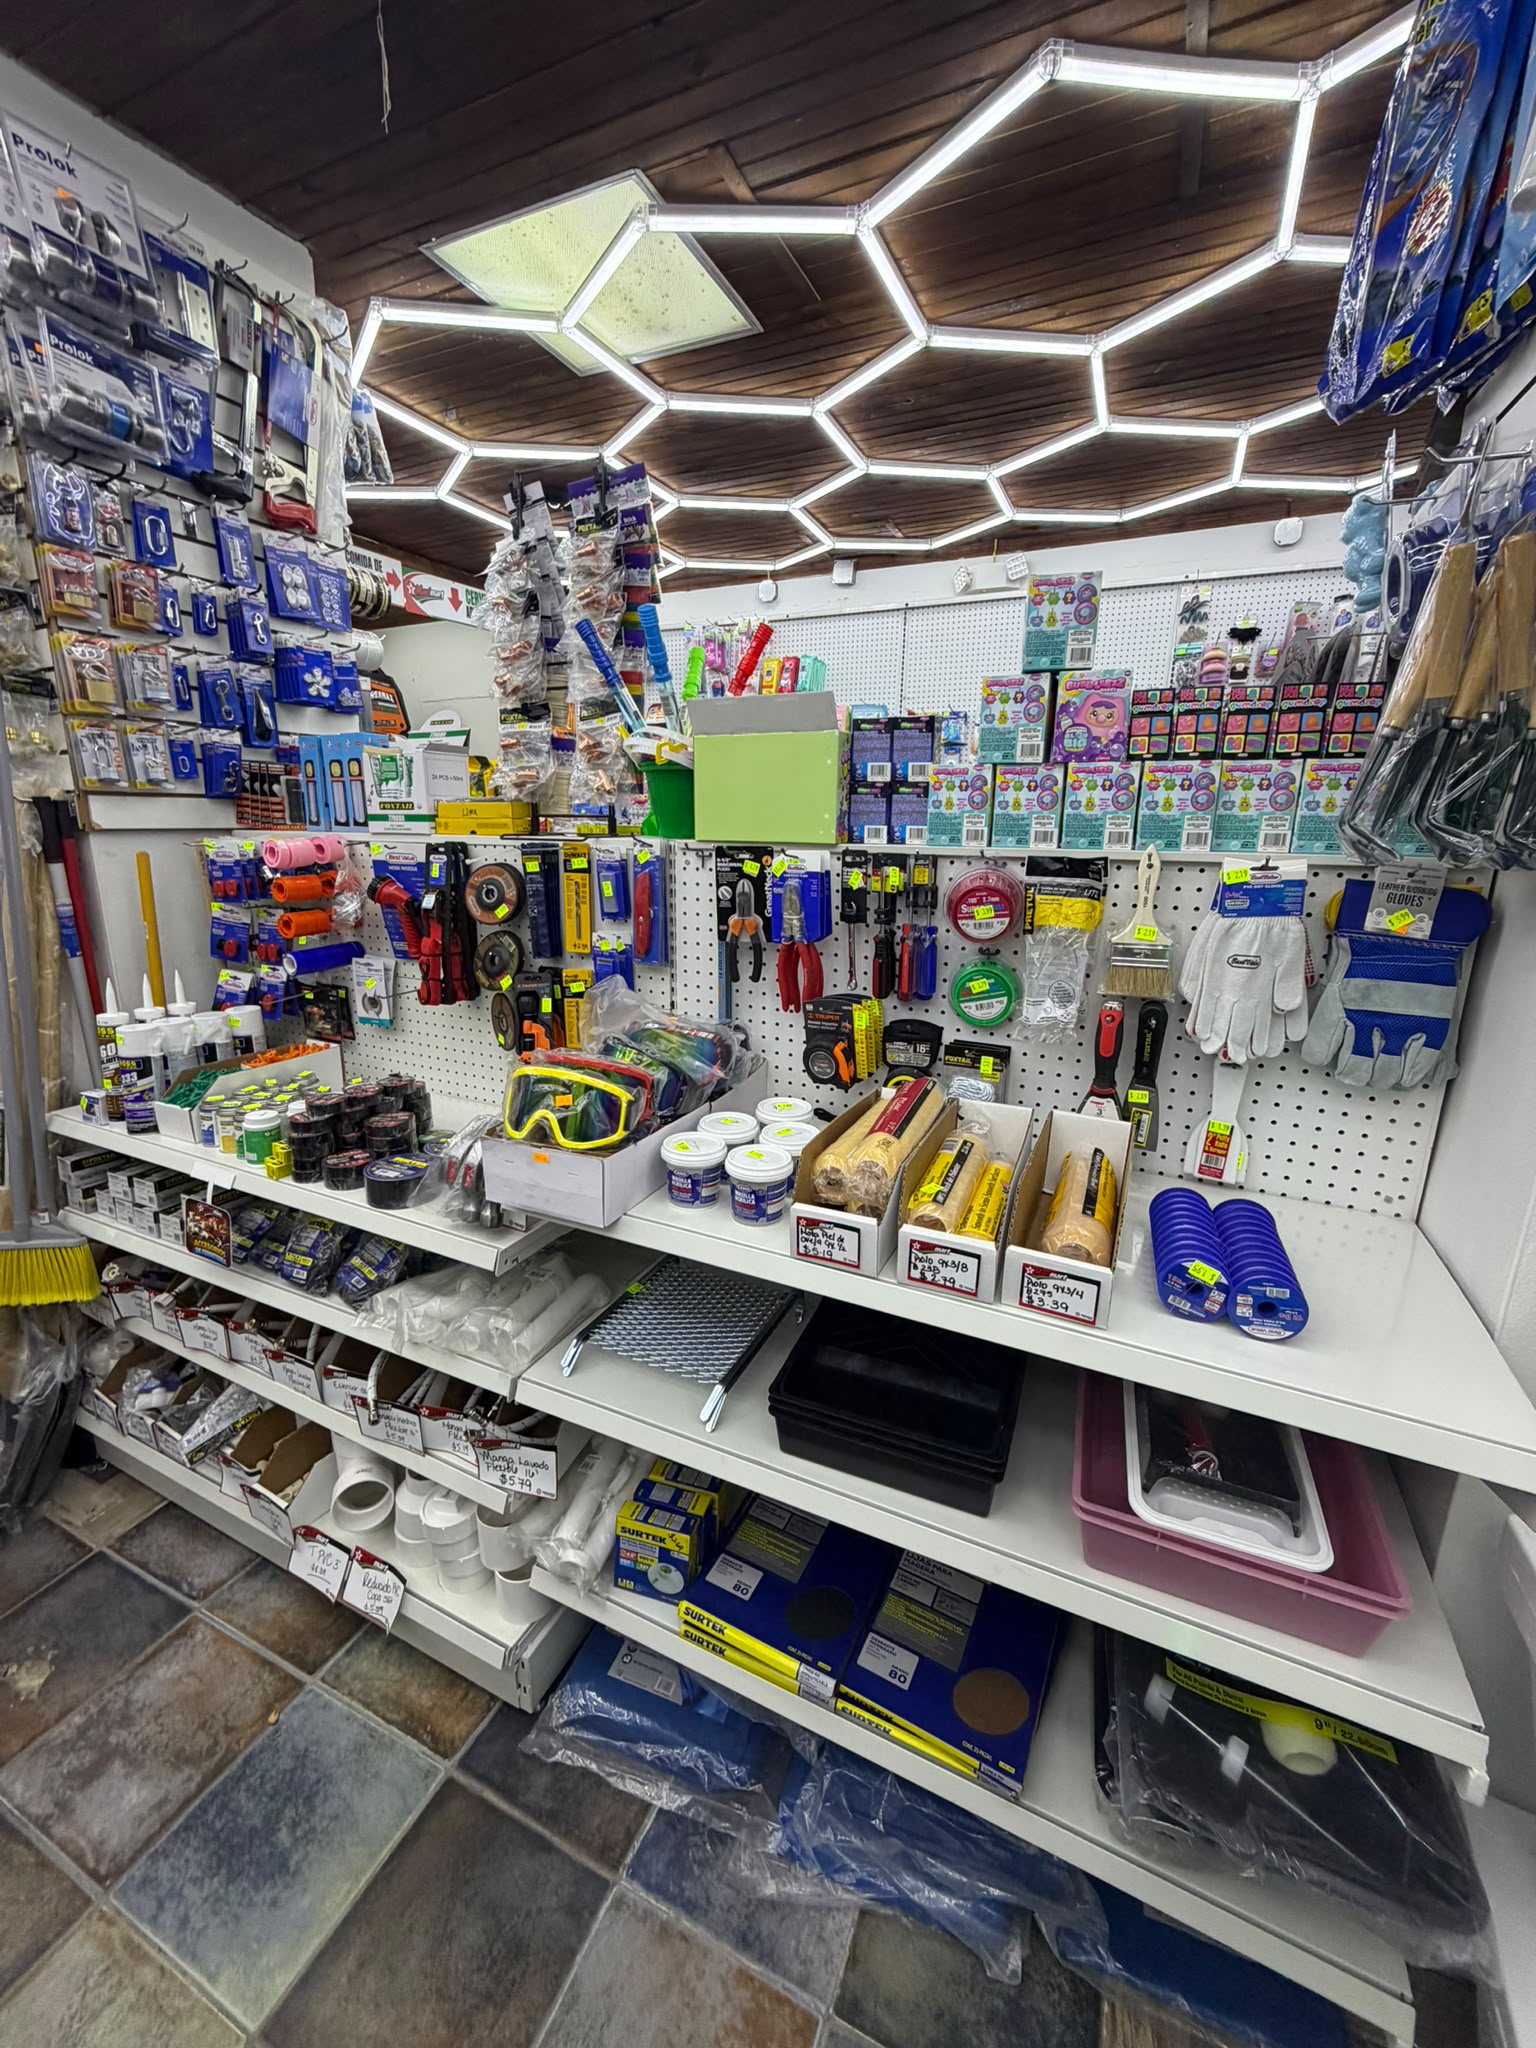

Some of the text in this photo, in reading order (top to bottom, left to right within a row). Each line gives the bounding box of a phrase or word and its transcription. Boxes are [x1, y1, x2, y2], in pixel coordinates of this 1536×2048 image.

[11, 132, 78, 179] Prolok
[49, 333, 94, 365] Prolok
[345, 549, 383, 572] COMIDA DE
[379, 802, 415, 810] FOXTAIL
[765, 866, 773, 917] GreatNeck
[1378, 881, 1438, 897] LEATHER WORKING
[1386, 891, 1424, 908] GLOVES
[1024, 887, 1035, 930] PRETUL
[915, 1043, 926, 1053] 16
[945, 1055, 973, 1064] FOXTAIL
[1215, 1141, 1229, 1149] Knife
[1216, 1134, 1230, 1142] Putty
[735, 1191, 755, 1199] MASILLA
[821, 1230, 835, 1240] Piel
[838, 1233, 845, 1243] de
[803, 1245, 833, 1260] $5.19
[919, 1271, 956, 1288] $2.79
[1026, 1295, 1069, 1312] $3.39
[333, 1371, 348, 1379] mart
[446, 1412, 463, 1420] mart
[501, 1441, 520, 1449] mart
[518, 1456, 550, 1471] Lavado
[620, 1526, 667, 1545] SURTEK
[308, 1545, 318, 1557] T
[318, 1549, 333, 1567] PVC
[904, 1557, 935, 1576] MADERA
[732, 1583, 749, 1596] 80
[683, 1606, 727, 1636] SURTEK
[683, 1629, 727, 1657] SURTEK
[888, 1668, 908, 1685] 80
[1314, 1718, 1331, 1731] 9"
